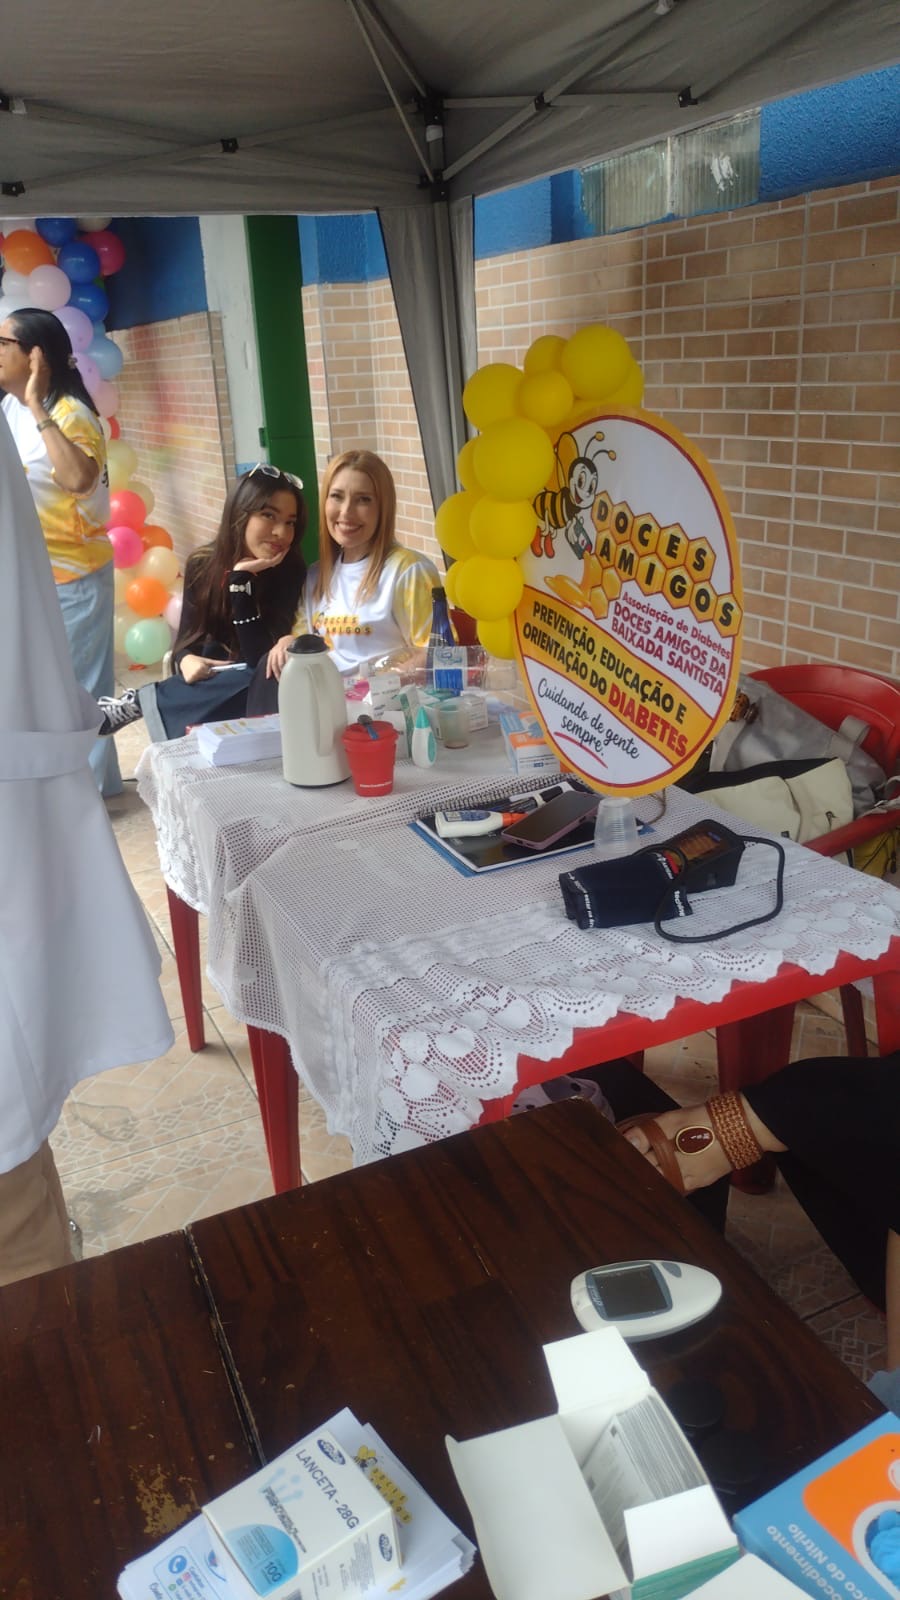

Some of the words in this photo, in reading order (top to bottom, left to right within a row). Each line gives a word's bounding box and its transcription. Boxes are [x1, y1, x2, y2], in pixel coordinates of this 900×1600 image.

[597, 499, 706, 571] DOCES
[599, 538, 734, 626] AMIGOS
[533, 601, 597, 662] PREVENÇÃO,
[600, 648, 673, 713] EDUCAÇÃO
[677, 703, 687, 725] E
[612, 619, 663, 661] BAIXADA
[667, 651, 724, 696] SANTISTA
[614, 602, 652, 633] DOCES
[654, 626, 708, 666] AMIGOS
[710, 657, 726, 679] DA
[622, 592, 673, 626] Associação
[676, 619, 689, 634] de
[691, 625, 732, 660] Diabetes
[523, 622, 587, 682] ORIENTAÇÃO
[589, 670, 607, 694] DO
[608, 683, 688, 758] DIABETES
[538, 678, 589, 721] Cuidando
[591, 714, 605, 734] de
[603, 728, 640, 759] gente
[561, 715, 604, 756] sempre.
[296, 1448, 339, 1502] LANCETA
[336, 1503, 360, 1530] 28G
[265, 1561, 282, 1583] 100
[788, 1523, 828, 1564] Nitrilo
[826, 1562, 846, 1581] de
